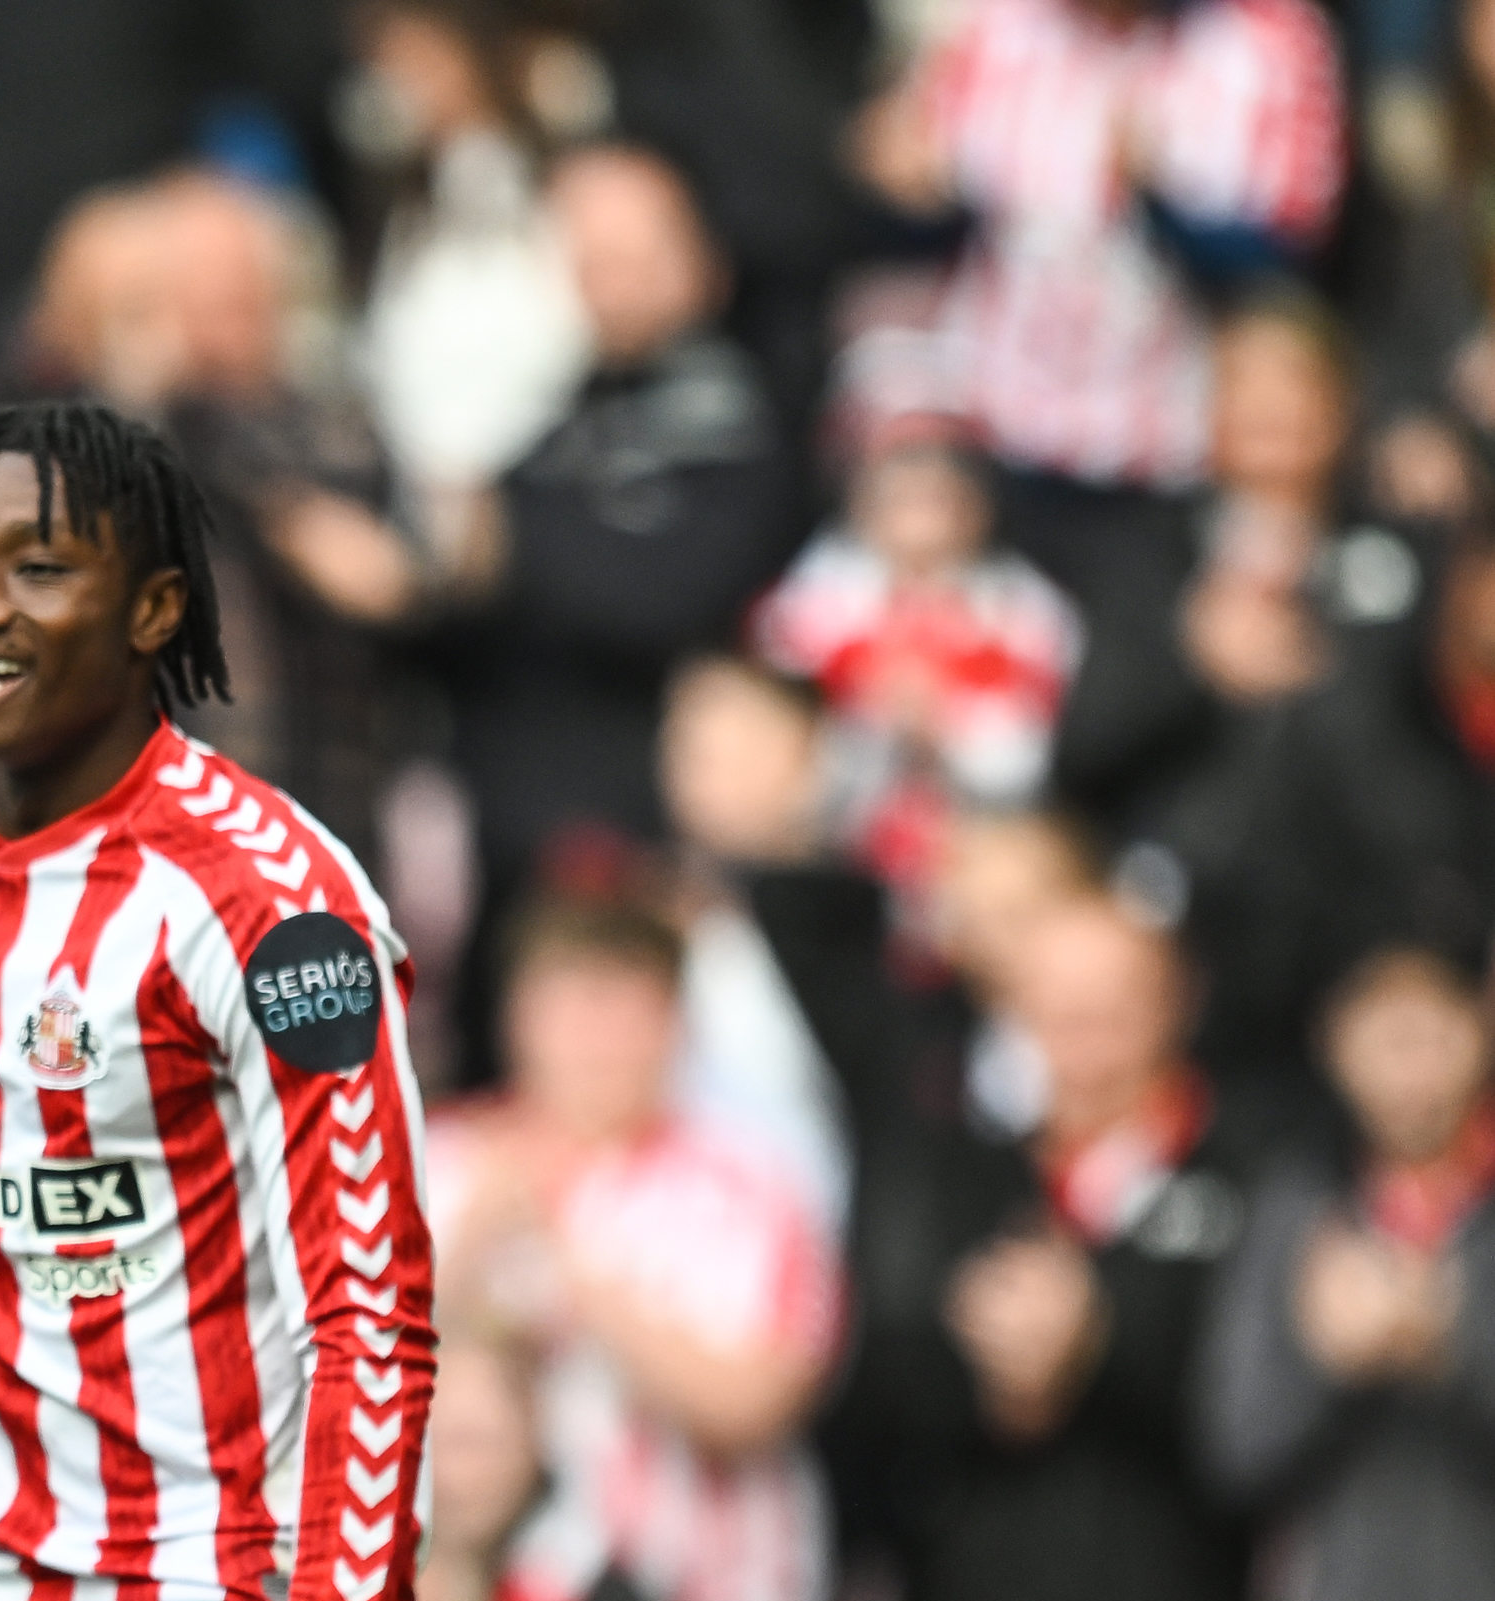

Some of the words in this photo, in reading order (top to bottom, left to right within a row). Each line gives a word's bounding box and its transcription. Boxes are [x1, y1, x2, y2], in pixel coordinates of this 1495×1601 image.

[254, 952, 372, 1004] SERIÖS
[264, 989, 373, 1032] GROUP
[25, 1254, 157, 1300] Sports
